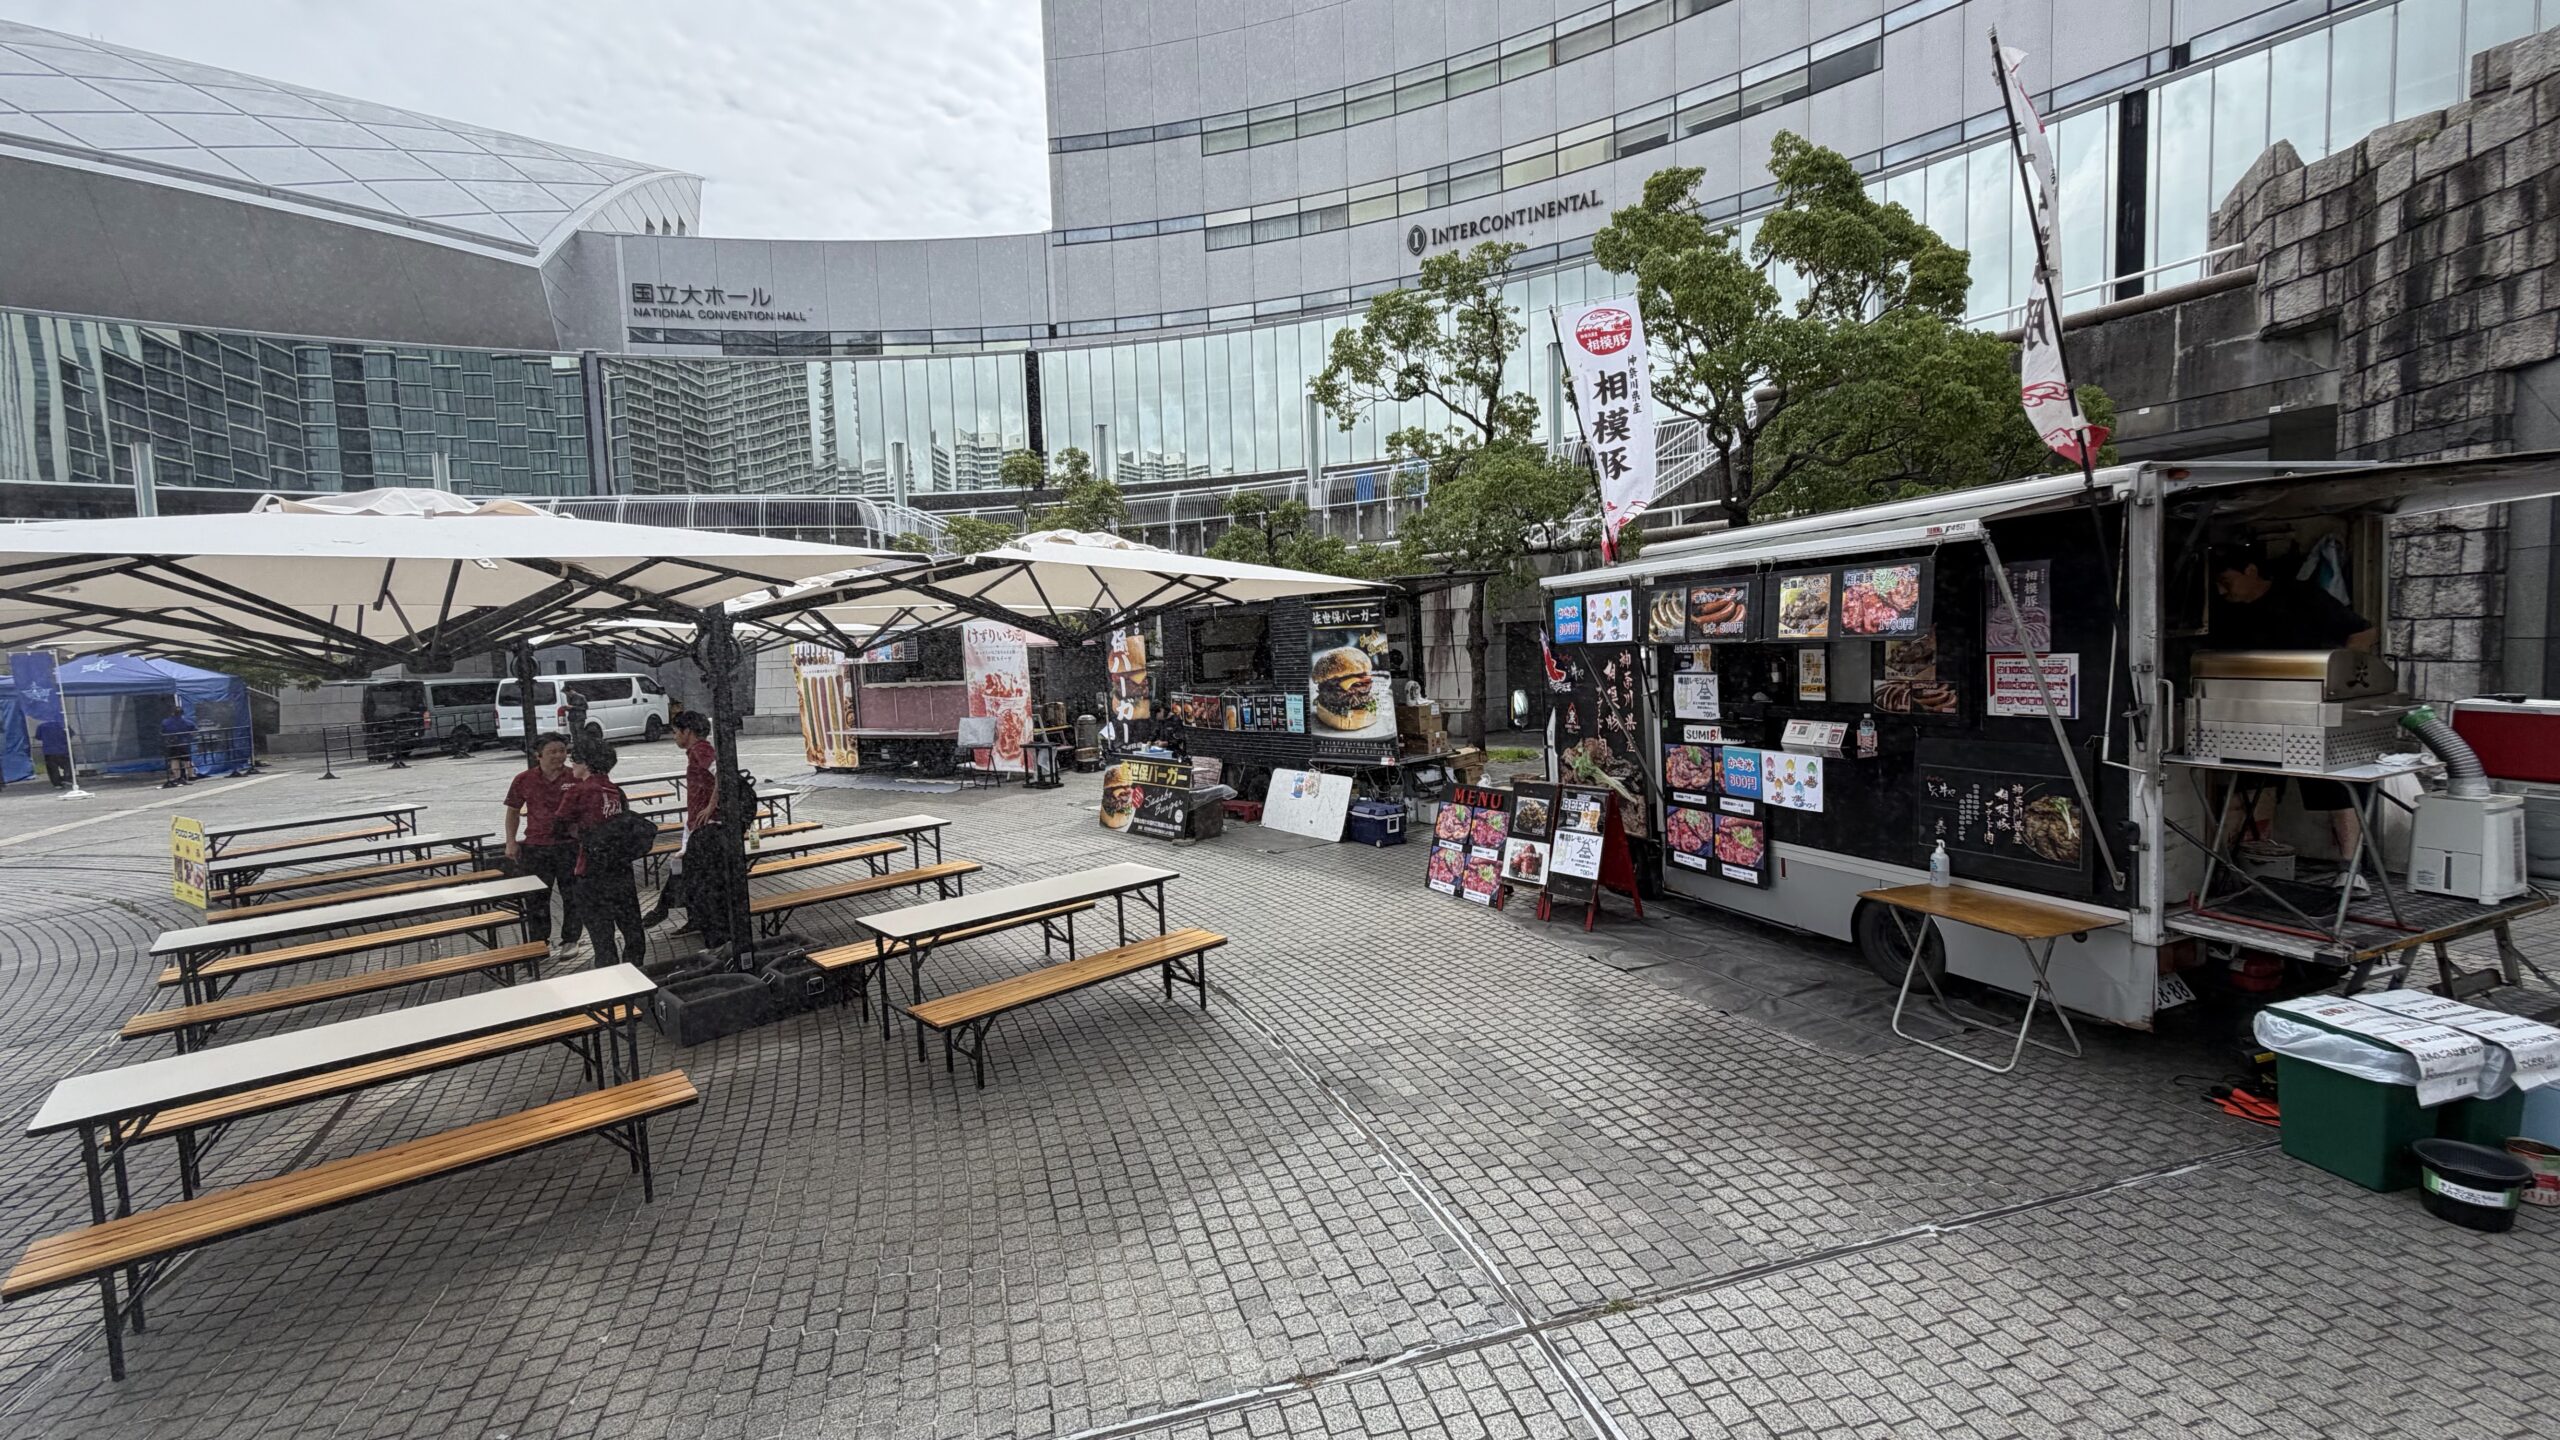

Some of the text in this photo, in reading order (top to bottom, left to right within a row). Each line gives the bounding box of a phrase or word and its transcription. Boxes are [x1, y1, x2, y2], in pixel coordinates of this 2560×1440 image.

[632, 282, 772, 307] 国立大ホール
[633, 307, 807, 322] NATIONAL CONVENTION HALL
[1587, 331, 1630, 352] 相模豚
[1628, 354, 1643, 415] 神奈川県産
[1592, 369, 1632, 481] 相模豚
[2024, 569, 2038, 607] 相模豚
[1312, 609, 1380, 625] 佐世保バーガー
[967, 628, 1022, 644] けずりいちご
[1727, 757, 1756, 772] かき氷
[1453, 787, 1503, 809] MENU
[1561, 799, 1591, 812] BEER
[2157, 980, 2191, 1006] 8-88
